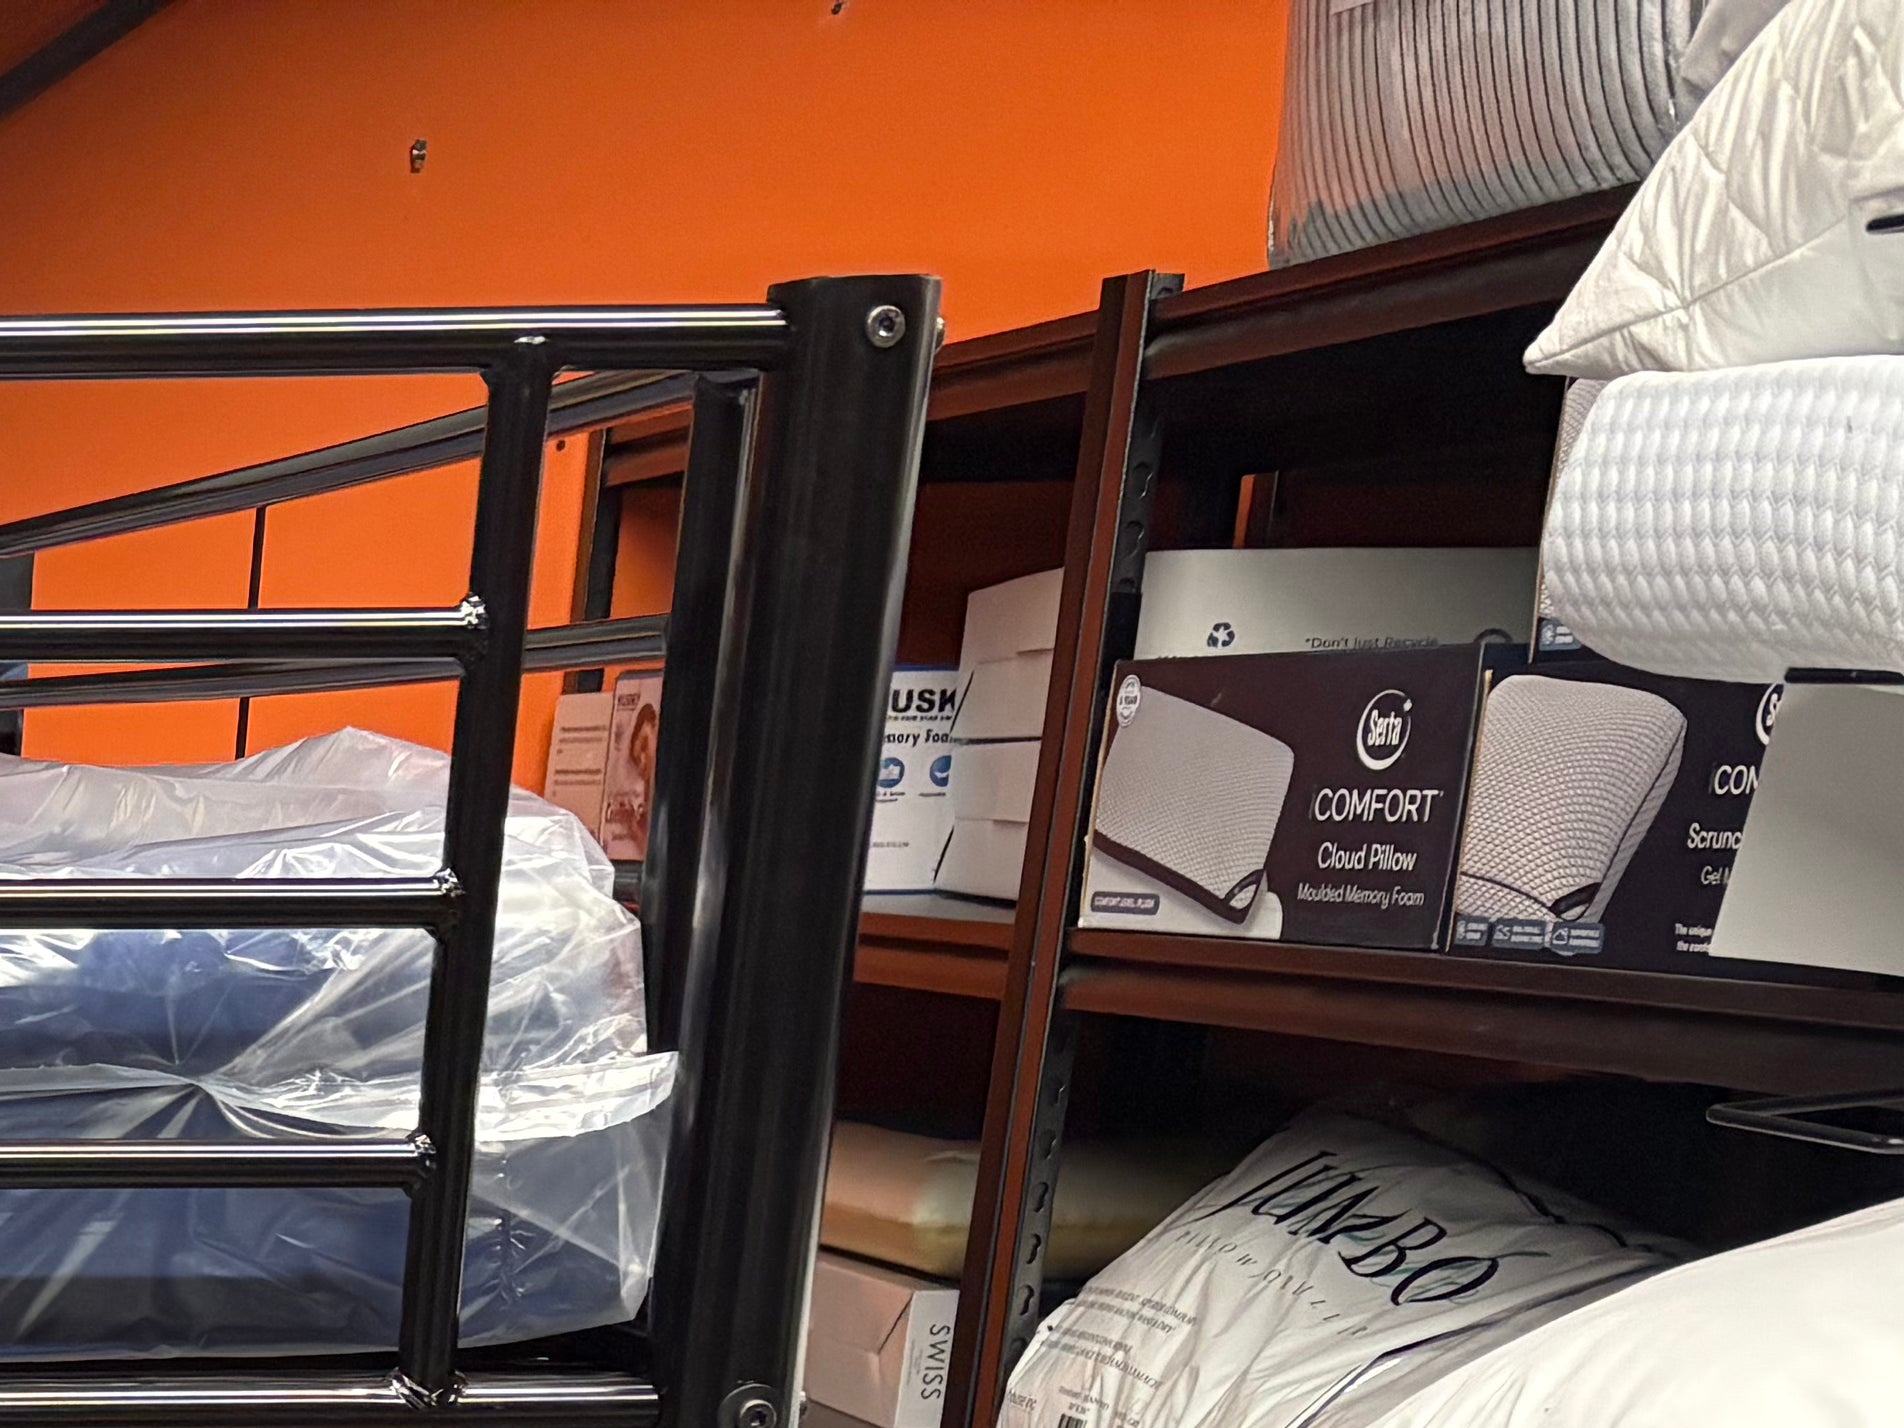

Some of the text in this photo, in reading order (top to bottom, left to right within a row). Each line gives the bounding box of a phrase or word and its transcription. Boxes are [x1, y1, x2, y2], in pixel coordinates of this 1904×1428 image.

[890, 688, 957, 713] USK
[924, 729, 951, 743] Foa
[1367, 709, 1403, 746] Serta
[1687, 822, 1742, 850] Scrunc
[1317, 841, 1417, 871] Cloud Pillow
[1345, 884, 1390, 910] Memory
[1392, 886, 1425, 906] Foam
[1192, 1150, 1500, 1307] JUMBO
[920, 1323, 951, 1399] SWISS
